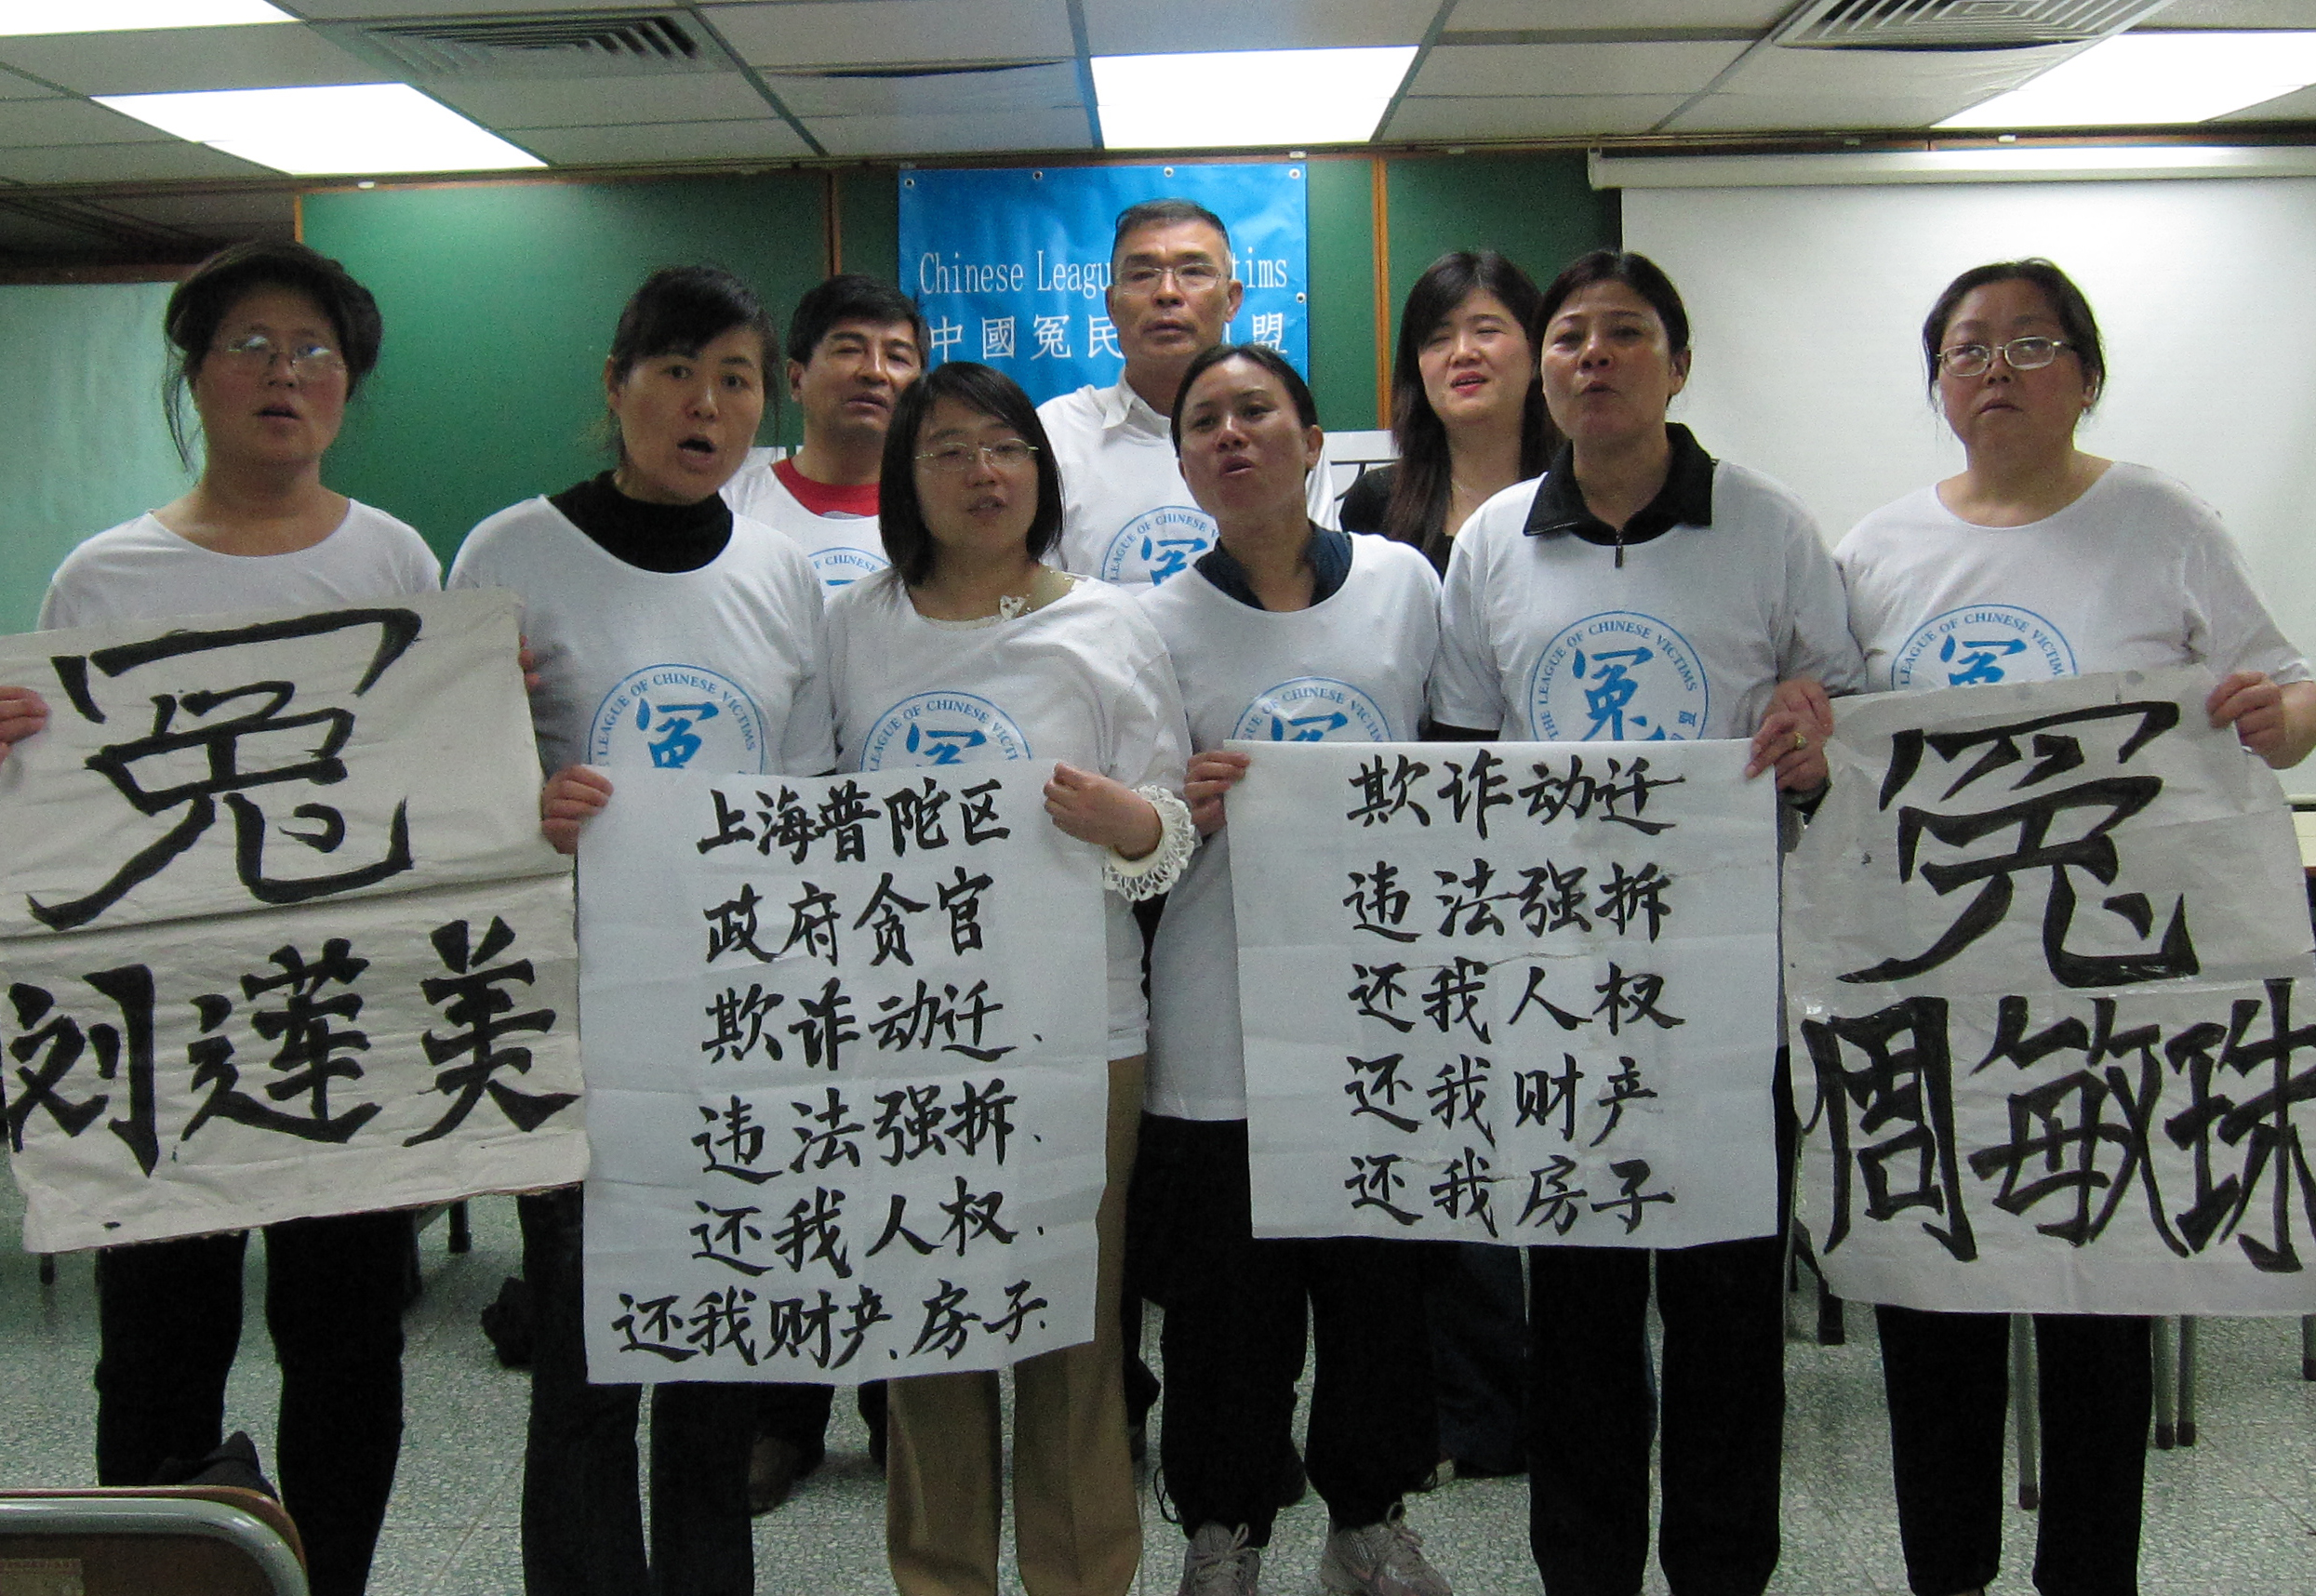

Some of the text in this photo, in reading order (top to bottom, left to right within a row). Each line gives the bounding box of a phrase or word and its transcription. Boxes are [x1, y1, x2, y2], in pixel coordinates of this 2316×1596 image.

[920, 246, 1287, 299] Chinese Leagu tims
[1137, 522, 1151, 535] OF
[1155, 512, 1207, 532] CHINESE
[1538, 646, 1567, 706] LEAGUE
[1566, 629, 1585, 648] OF
[1588, 619, 1653, 640] CHINESE
[1656, 633, 1698, 693] VICTIMS
[1900, 611, 2065, 685] LEAGUE OF CHINESE VICTIM
[597, 672, 757, 756] LEAGUE OF CHINESE VICTIMS
[903, 706, 922, 721] OF
[926, 699, 990, 725] CHINESE
[992, 722, 1019, 761] VICTI
[1282, 686, 1345, 705] CHINESE
[26, 607, 421, 931] 冤
[1347, 749, 1685, 840] 欺诈动迁
[697, 778, 1011, 866] 上海普陀区
[1836, 700, 2202, 989] 冤
[703, 866, 994, 966] 政府贪官
[1343, 858, 1671, 943] 违法强拆
[1348, 957, 1685, 1044] 还我人权
[1345, 1053, 1657, 1148] 还我财产
[1345, 1147, 1676, 1237] 还我房子
